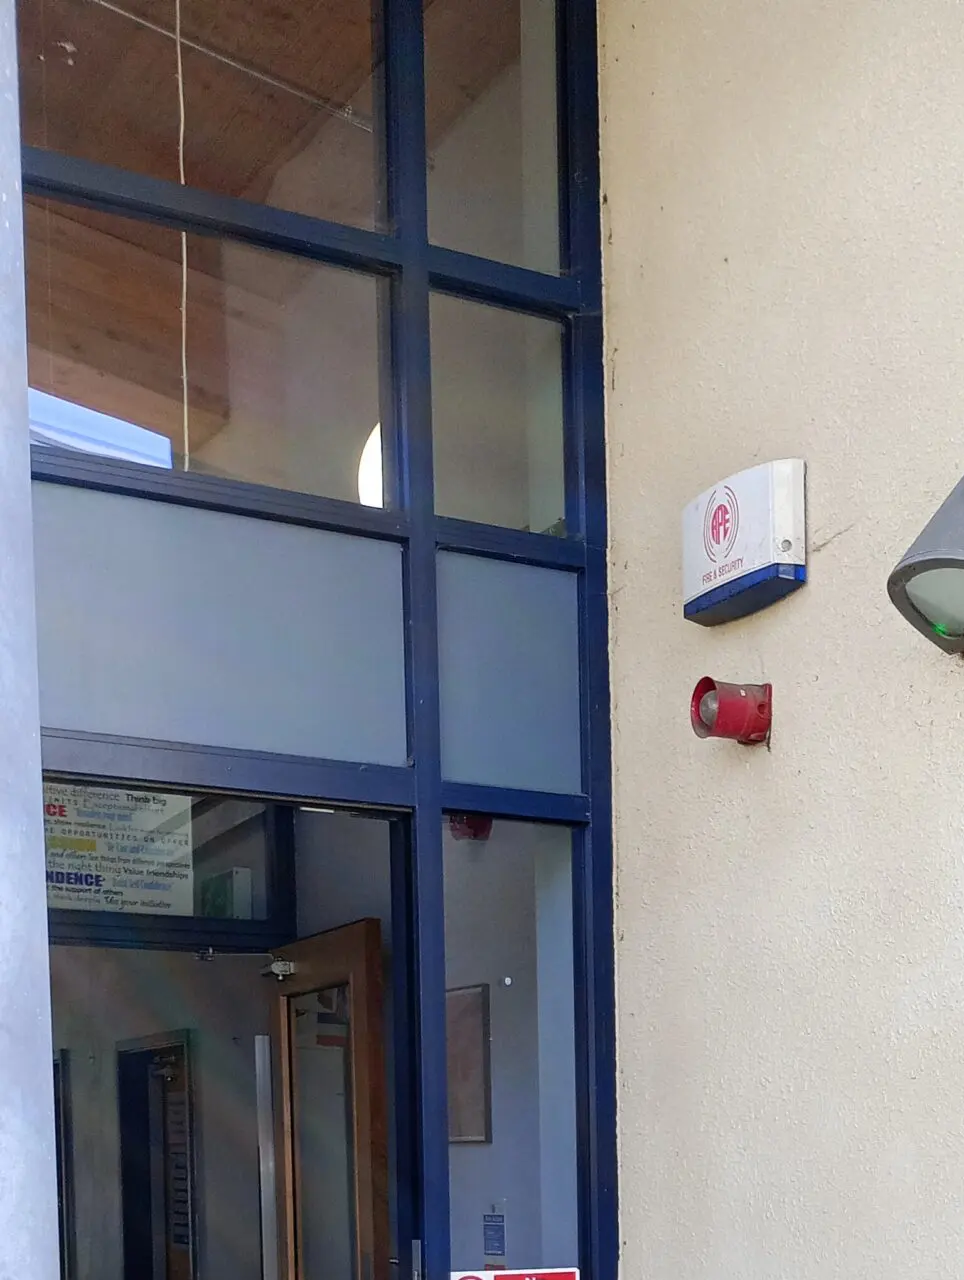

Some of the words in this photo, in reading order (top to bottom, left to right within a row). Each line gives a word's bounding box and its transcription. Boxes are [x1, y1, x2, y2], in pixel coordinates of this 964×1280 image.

[718, 556, 744, 577] SECURITY
[126, 793, 151, 803] Think
[61, 828, 138, 842] OPPORTUNITIES
[122, 865, 144, 876] Value
[46, 870, 104, 887] NDENCE
